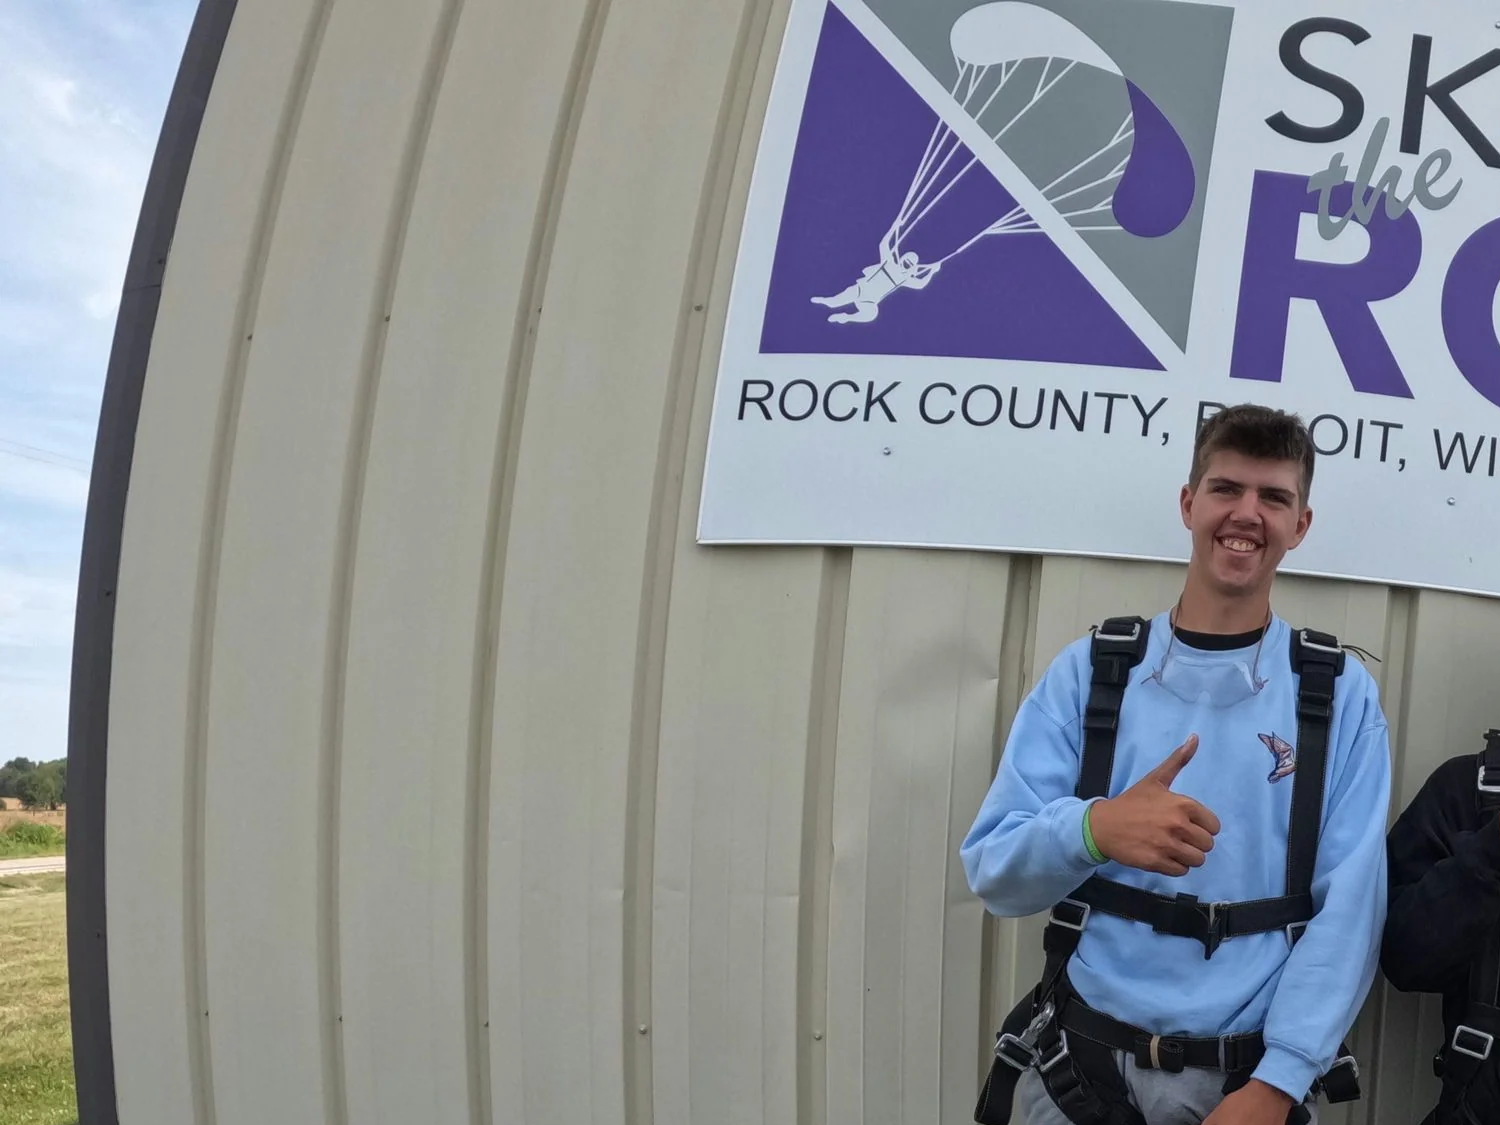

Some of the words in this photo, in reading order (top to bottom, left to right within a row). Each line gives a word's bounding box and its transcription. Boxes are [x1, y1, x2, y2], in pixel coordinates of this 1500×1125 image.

[1307, 116, 1463, 241] the
[736, 378, 903, 424] ROCK
[917, 381, 1171, 447] COUNTY,
[1195, 400, 1406, 472] OIT,
